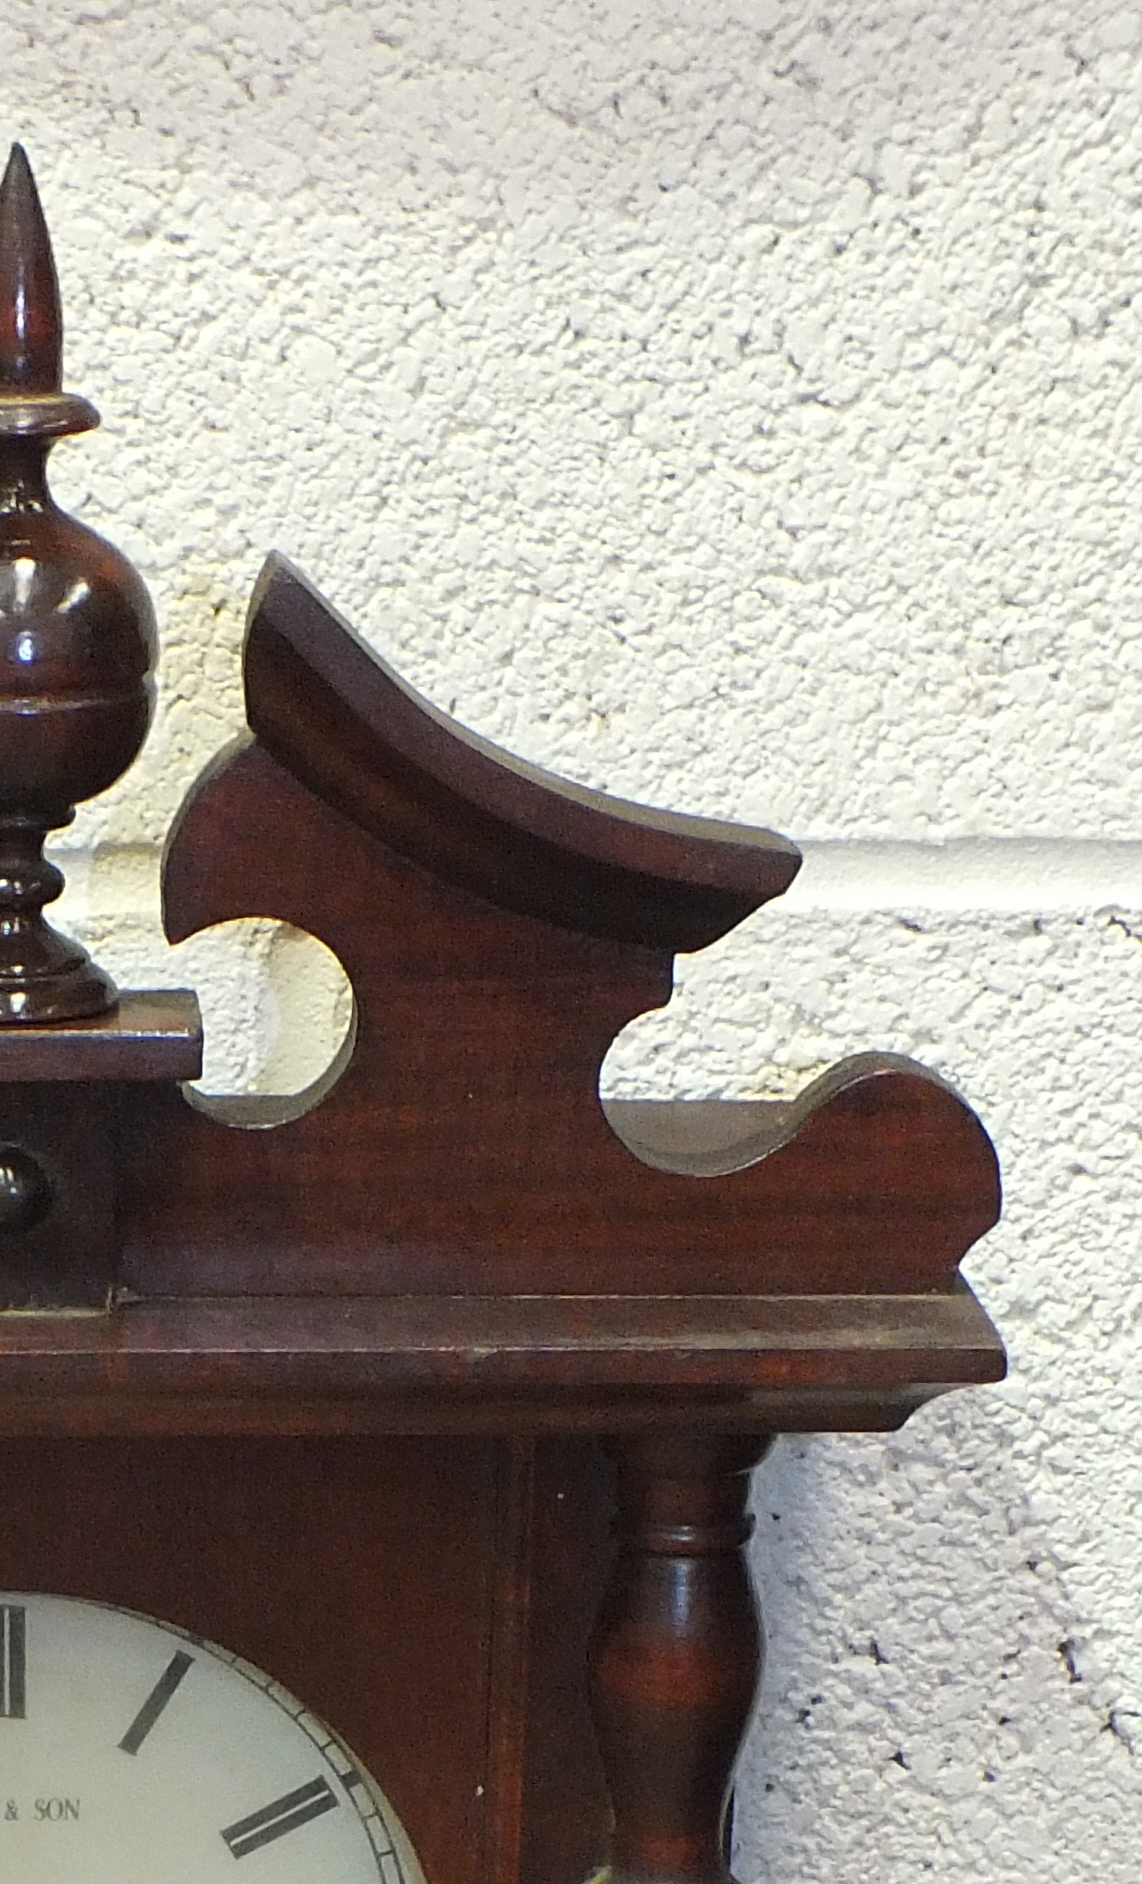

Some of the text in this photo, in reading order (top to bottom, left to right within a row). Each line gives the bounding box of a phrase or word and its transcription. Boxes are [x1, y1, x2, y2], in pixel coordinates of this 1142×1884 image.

[118, 1649, 195, 1756] I
[4, 1799, 19, 1821] &
[33, 1798, 80, 1821] SON
[219, 1775, 339, 1860] II
